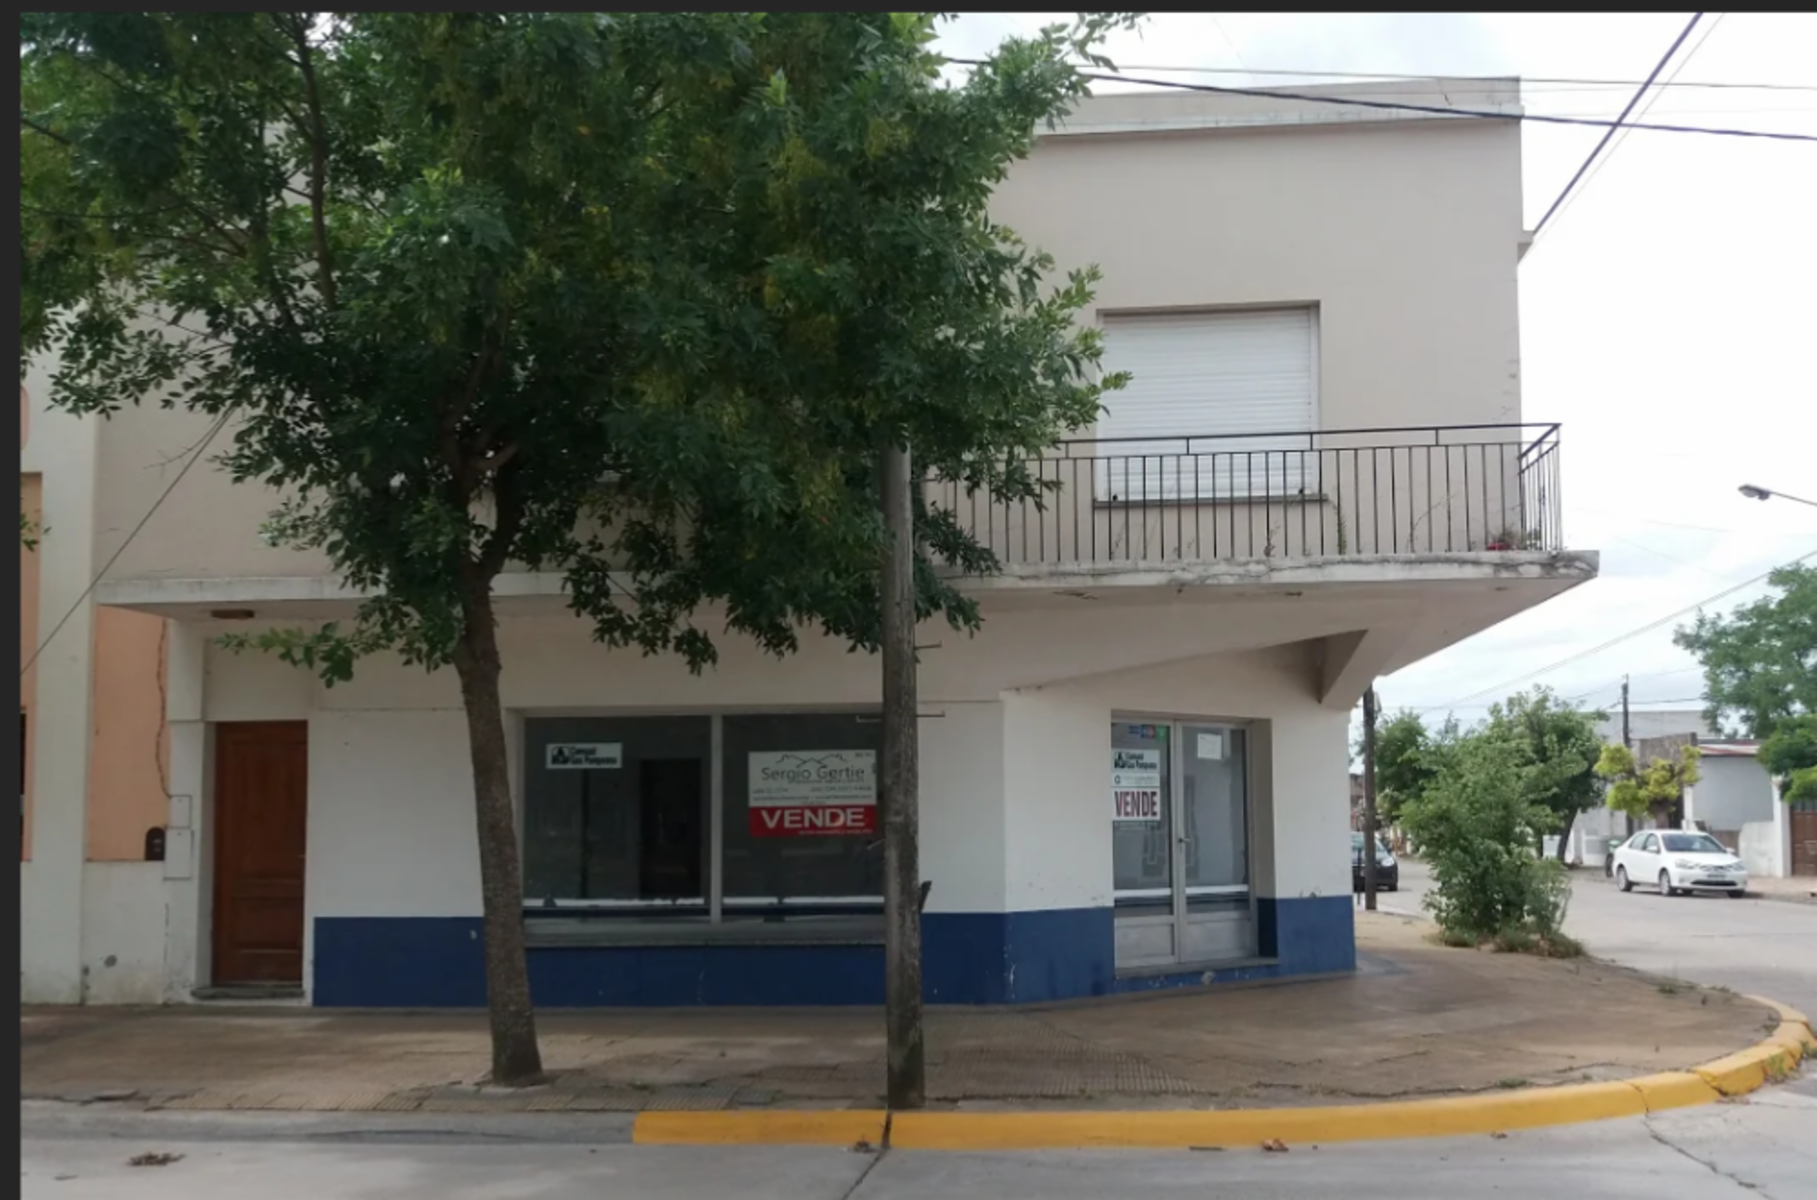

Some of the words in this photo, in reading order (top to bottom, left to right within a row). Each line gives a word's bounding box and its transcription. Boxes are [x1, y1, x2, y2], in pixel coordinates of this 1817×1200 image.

[761, 767, 812, 783] Sergio
[817, 765, 865, 780] Gertie
[1114, 791, 1157, 817] VENDE
[761, 807, 865, 829] VENDE
